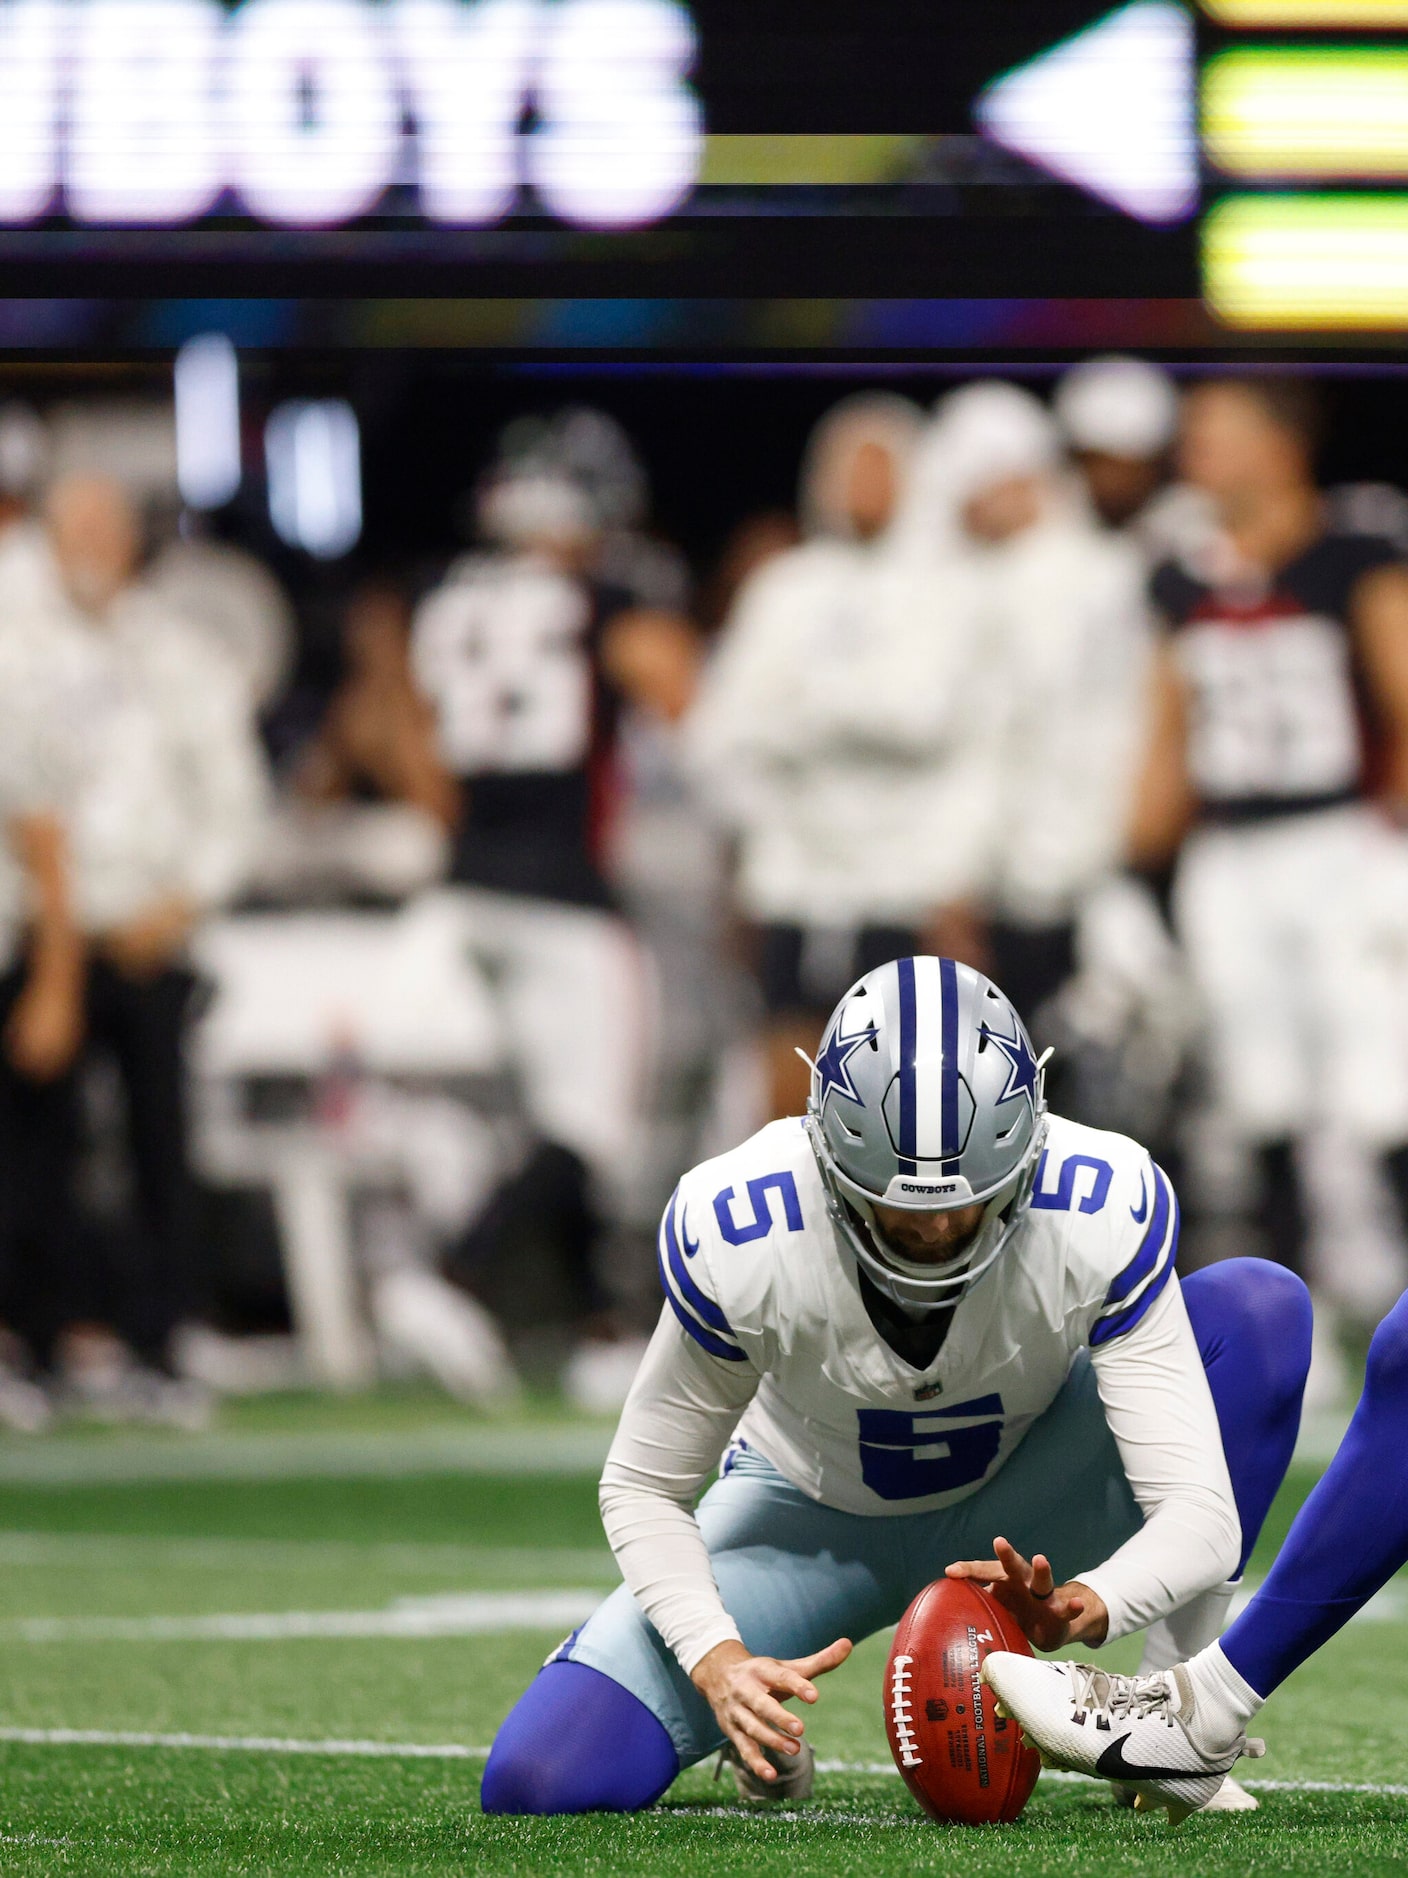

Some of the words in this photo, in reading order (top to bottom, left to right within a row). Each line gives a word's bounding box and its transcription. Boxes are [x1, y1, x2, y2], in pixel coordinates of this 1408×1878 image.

[712, 1170, 805, 1247] 5
[901, 1183, 956, 1194] COWBOYS
[1029, 1148, 1115, 1216] 5
[856, 1392, 1005, 1501] 5
[967, 1625, 979, 1668] LEAGUE
[970, 1671, 984, 1731] FOOTBALL
[976, 1734, 990, 1788] NATIONAL
